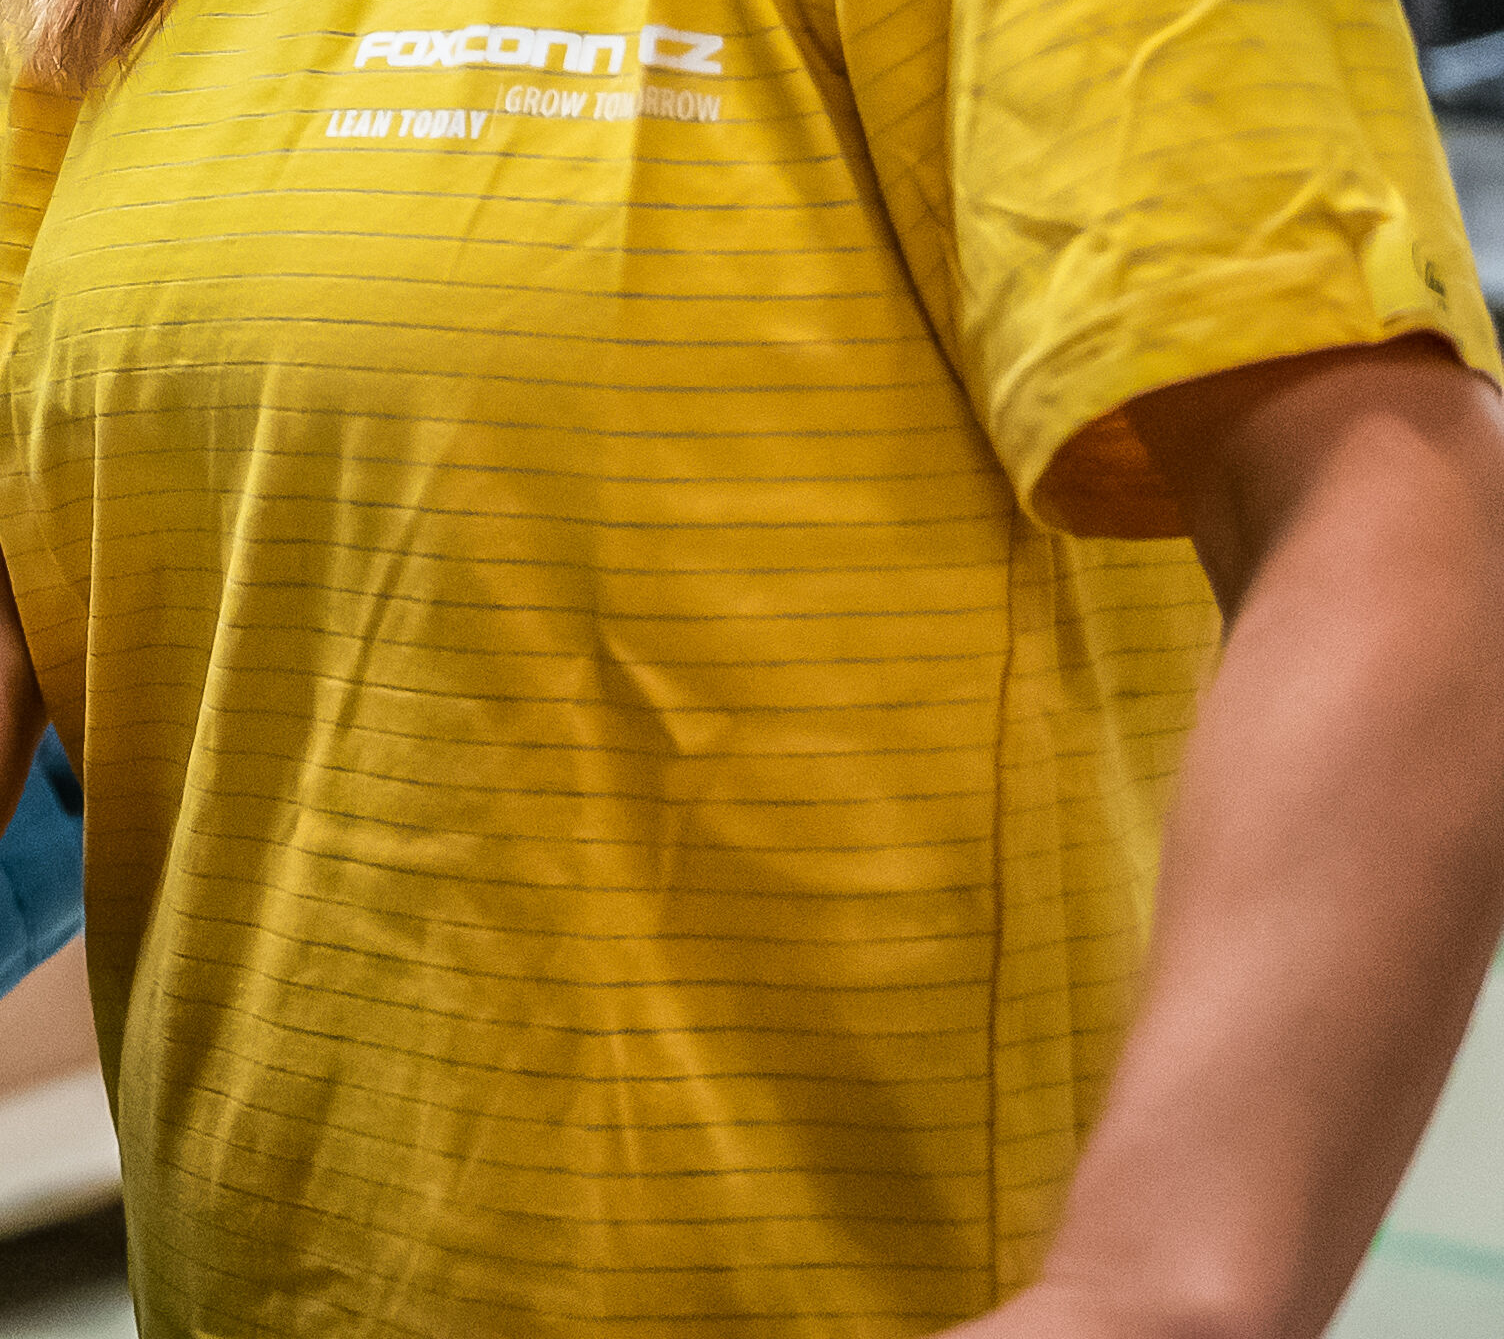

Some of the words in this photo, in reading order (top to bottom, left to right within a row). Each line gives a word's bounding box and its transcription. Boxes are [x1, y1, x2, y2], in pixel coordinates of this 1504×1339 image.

[639, 24, 724, 75] CZ
[504, 85, 588, 118] GROW
[325, 109, 392, 138] LEAN
[398, 109, 488, 140] TODAY
